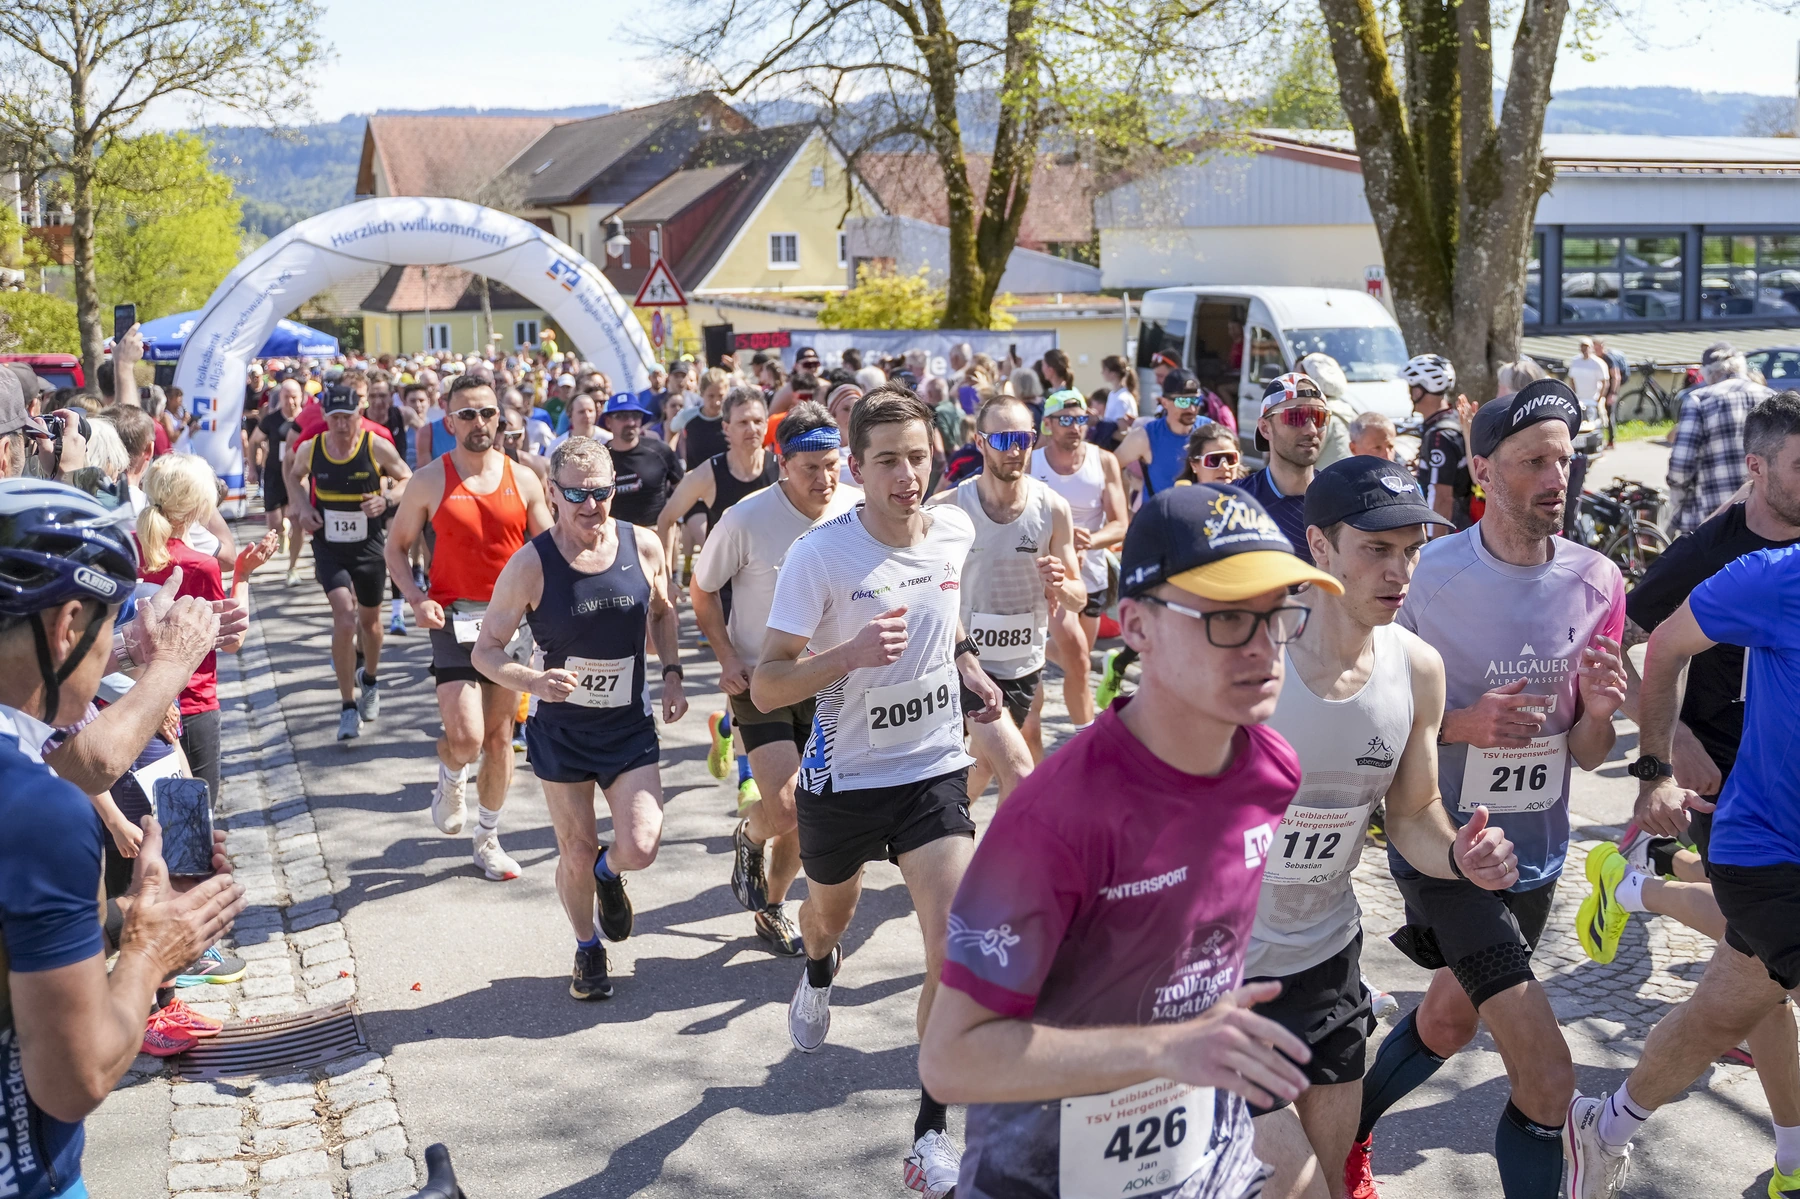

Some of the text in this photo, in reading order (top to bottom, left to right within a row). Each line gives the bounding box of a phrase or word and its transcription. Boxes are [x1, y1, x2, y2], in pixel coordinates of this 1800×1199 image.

[330, 217, 508, 248] Herzlich willkommen!
[194, 331, 222, 388] Volksbank
[1511, 394, 1578, 427] DYNAFIT
[334, 521, 357, 532] 134
[79, 571, 114, 593] ABUS
[907, 575, 932, 586] TERREX
[972, 627, 1032, 648] 20883
[1484, 658, 1570, 679] ALLGÄUER
[580, 674, 620, 692] 427
[1489, 675, 1564, 685] ALPEWASSER
[870, 683, 949, 730] 20919
[1383, 752, 1394, 761] SV
[1502, 748, 1560, 759] Hergensweiler
[1489, 763, 1548, 792] 216
[1294, 810, 1349, 820] Leiblachlauf
[1524, 801, 1546, 810] AOK
[1280, 817, 1357, 830] SV Hergensweiler
[1283, 831, 1342, 860] 112
[1284, 861, 1322, 869] Sebastian
[1106, 865, 1189, 901] INTERSPORT
[1307, 873, 1330, 883] AOK
[1155, 966, 1234, 1005] Trollinger
[1149, 990, 1222, 1021] Maratho
[1085, 1083, 1197, 1125] TSV Hergensweile
[1110, 1080, 1182, 1108] Leiblachla
[1580, 1104, 1596, 1130] balance
[1587, 1112, 1596, 1127] new
[1103, 1105, 1187, 1163] 426
[1137, 1160, 1158, 1172] Jan
[1122, 1175, 1154, 1192] AOK
